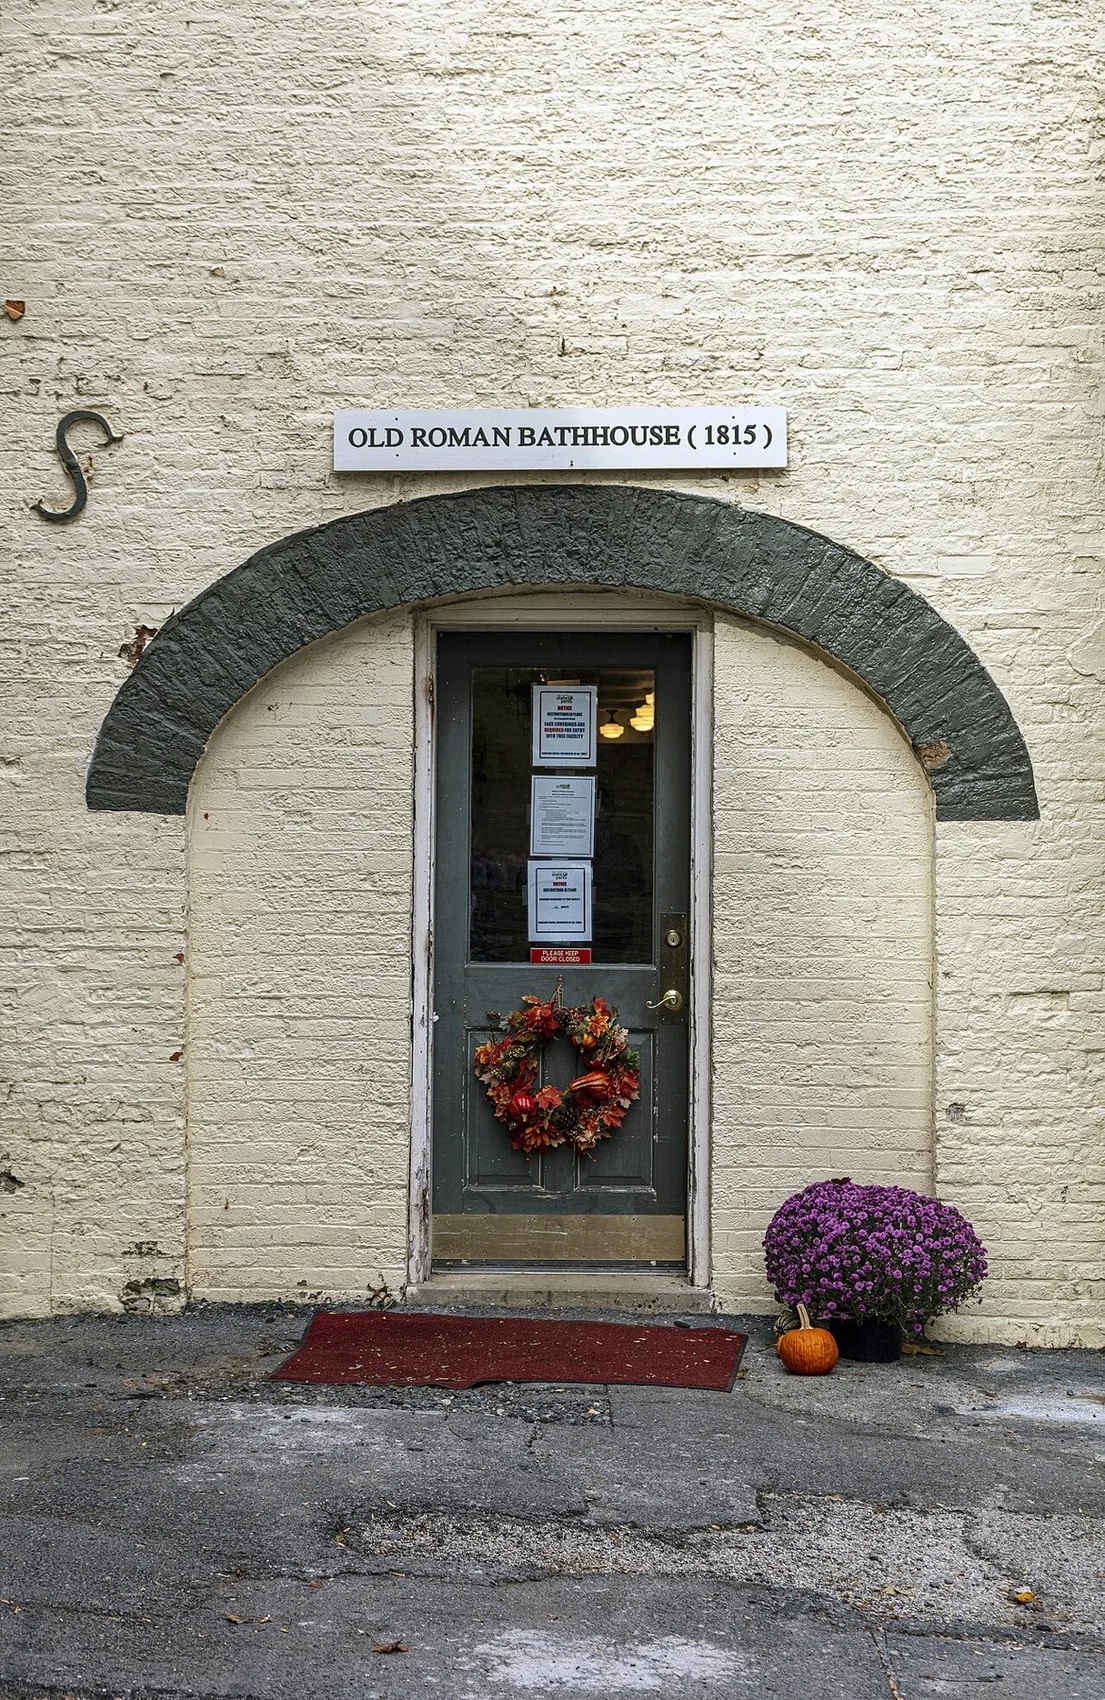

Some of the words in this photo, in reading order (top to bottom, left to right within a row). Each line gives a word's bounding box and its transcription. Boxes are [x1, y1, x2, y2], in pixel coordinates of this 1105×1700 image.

[348, 428, 404, 448] OLD
[410, 426, 510, 448] ROMAN
[518, 425, 681, 447] BATHHOUSE
